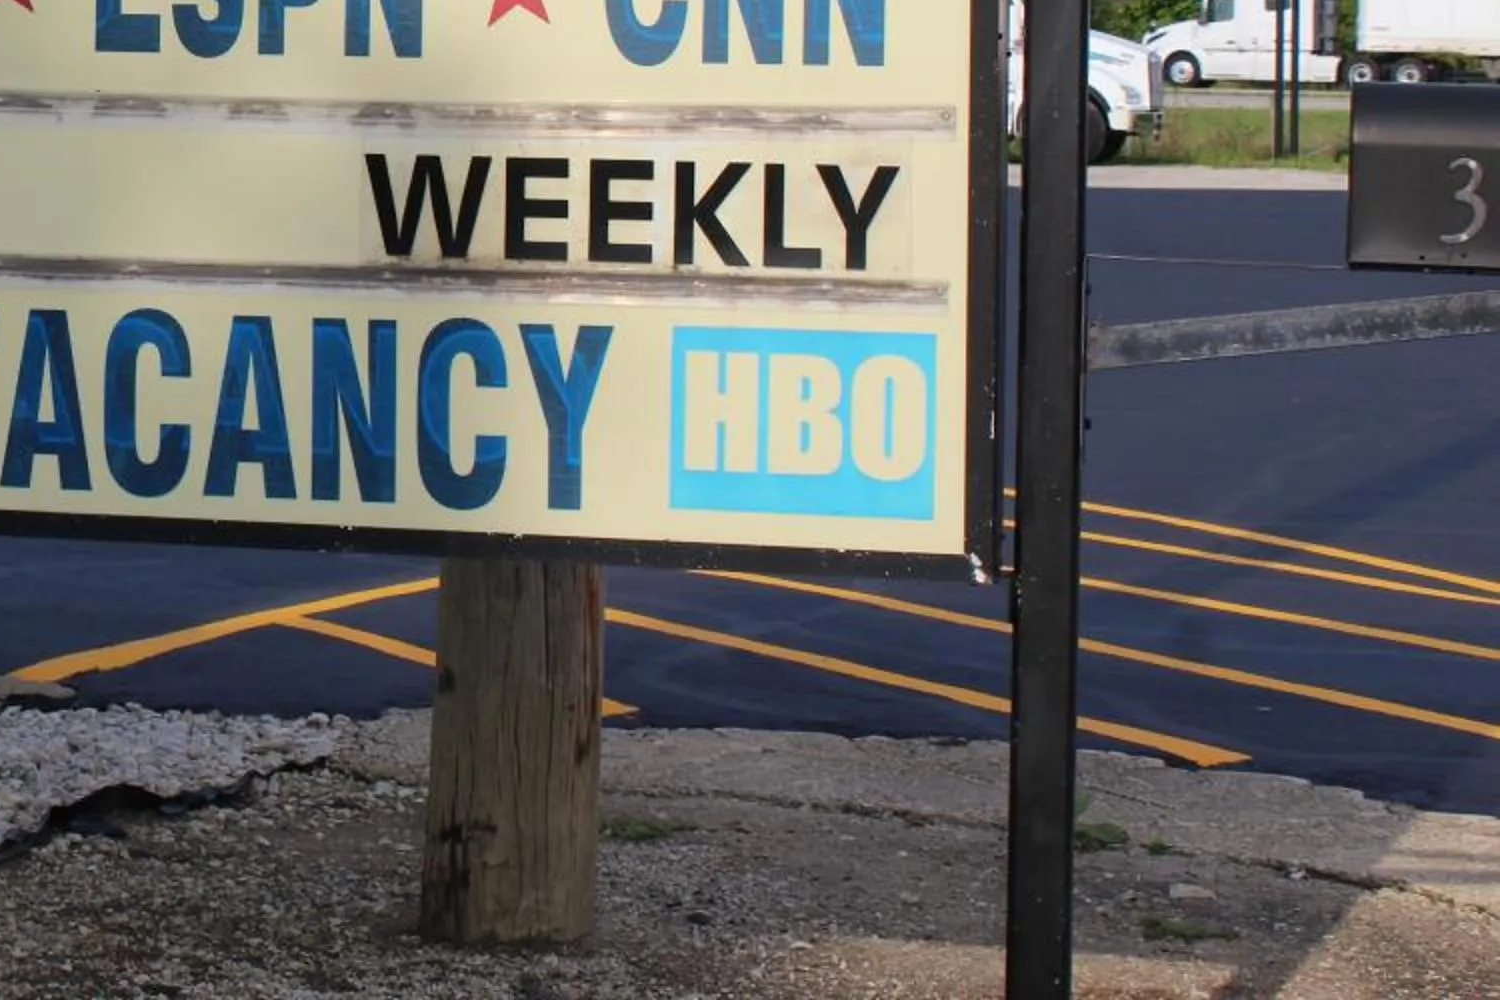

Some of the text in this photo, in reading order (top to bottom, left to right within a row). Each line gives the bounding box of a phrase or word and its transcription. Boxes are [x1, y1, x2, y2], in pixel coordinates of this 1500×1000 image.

[364, 152, 901, 271] WEEKLY
[1439, 157, 1489, 244] 3
[682, 348, 928, 482] HBO
